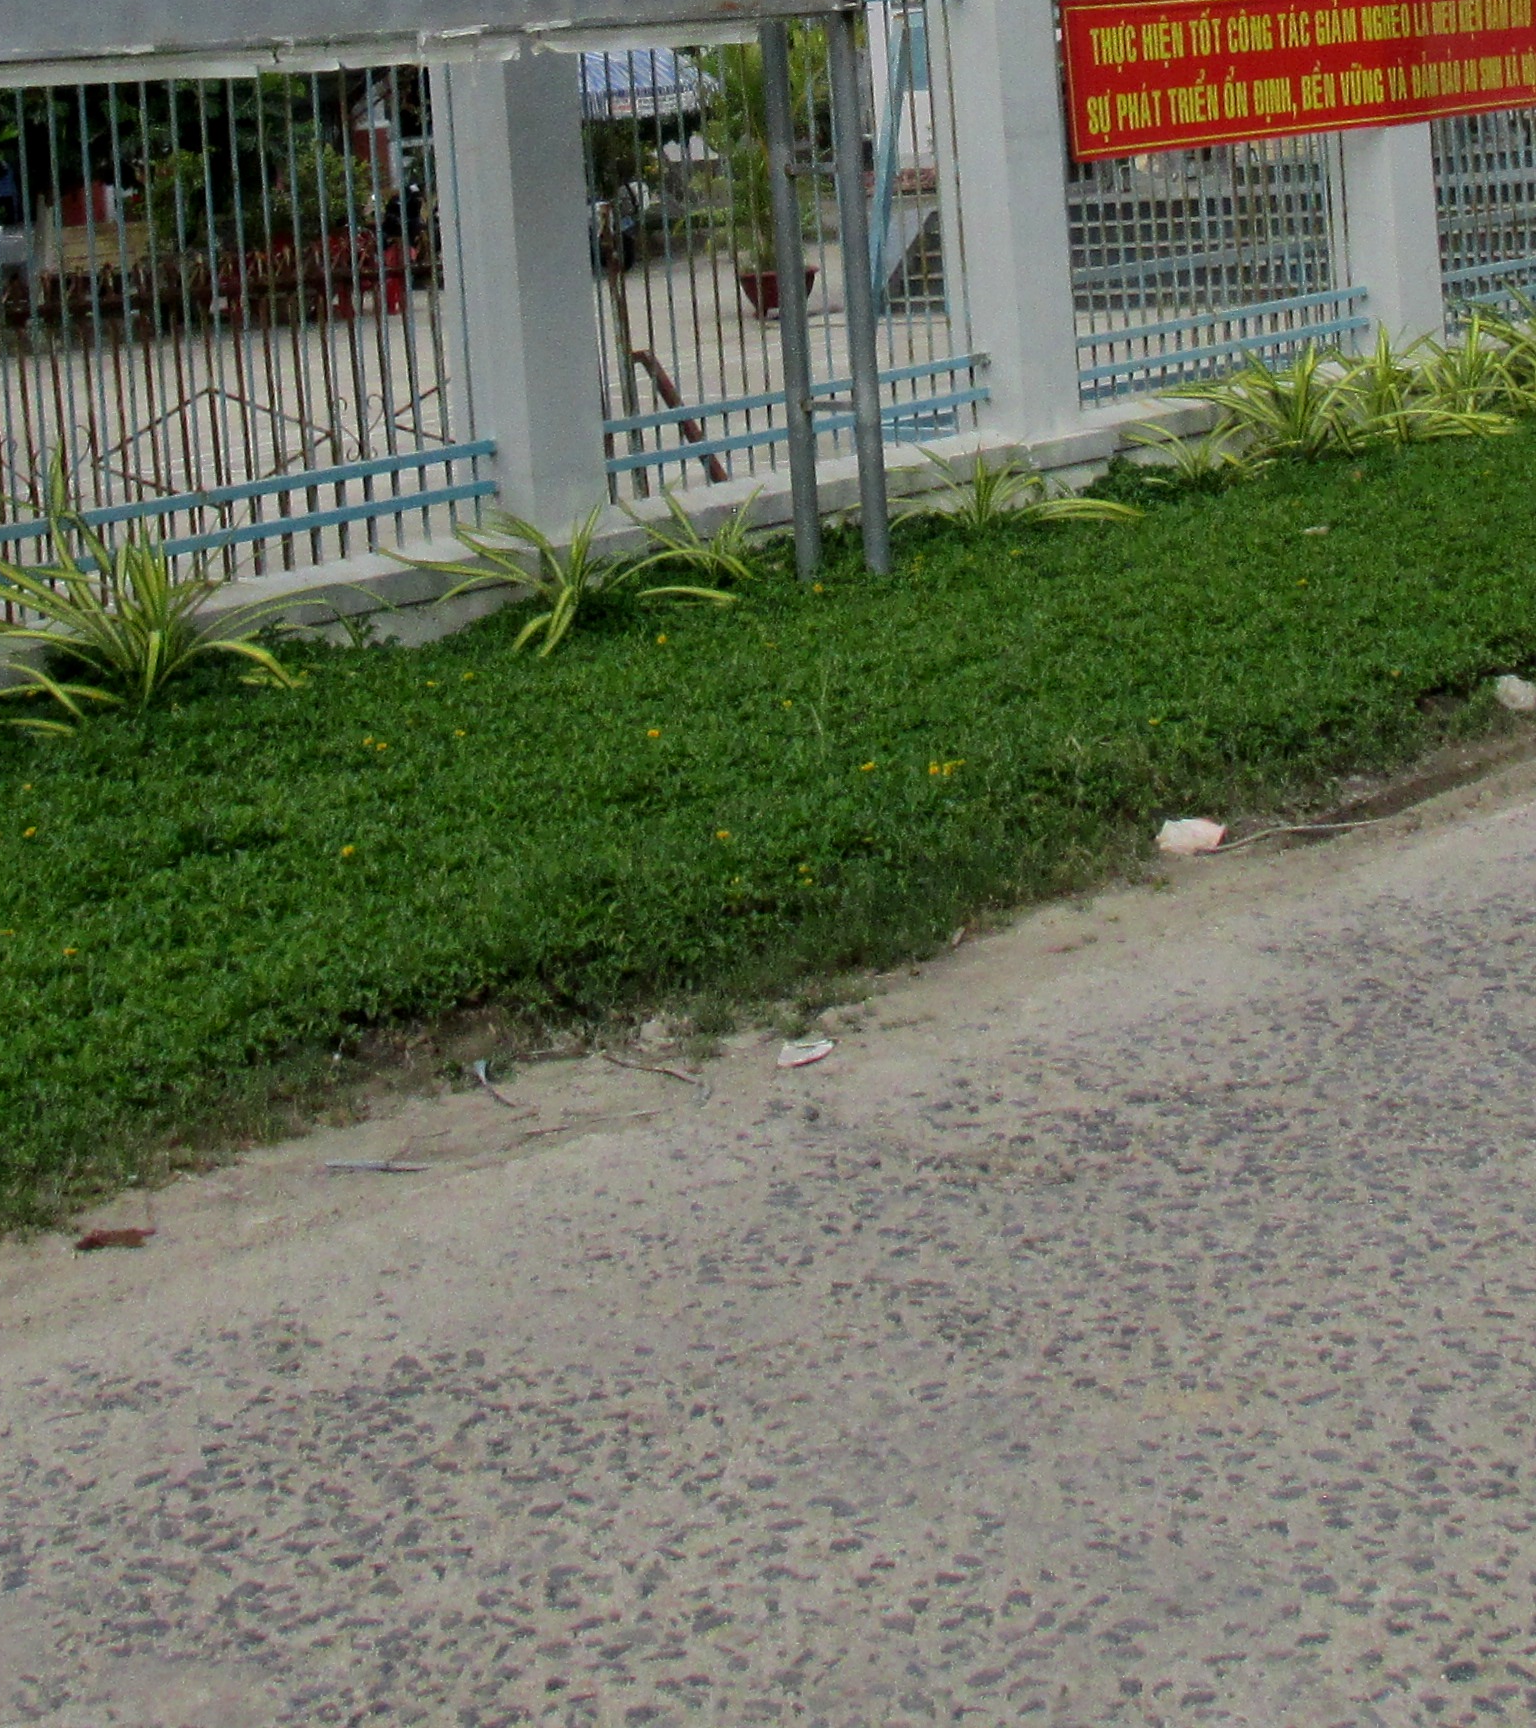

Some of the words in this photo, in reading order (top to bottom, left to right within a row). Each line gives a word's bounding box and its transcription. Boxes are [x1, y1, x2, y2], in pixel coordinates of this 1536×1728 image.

[1090, 20, 1137, 73] THỰC
[1142, 15, 1185, 68] HIỆN
[1189, 8, 1221, 56] TỐT
[1227, 9, 1273, 53] CÔNG
[1277, 4, 1311, 48] TÁC
[1087, 89, 1111, 143] SỰ
[1116, 83, 1161, 131] PHÁT
[1168, 69, 1219, 125] TRIỂN
[1224, 66, 1249, 119] ỔN
[1253, 77, 1297, 123] ĐỊNH,
[1301, 59, 1336, 110] BỀN
[1341, 62, 1384, 106] VỮNG
[1388, 57, 1407, 102] VÀ
[1411, 51, 1439, 99] ĐẢM
[1440, 48, 1461, 95] BẢO
[1505, 47, 1520, 87] XÃ
